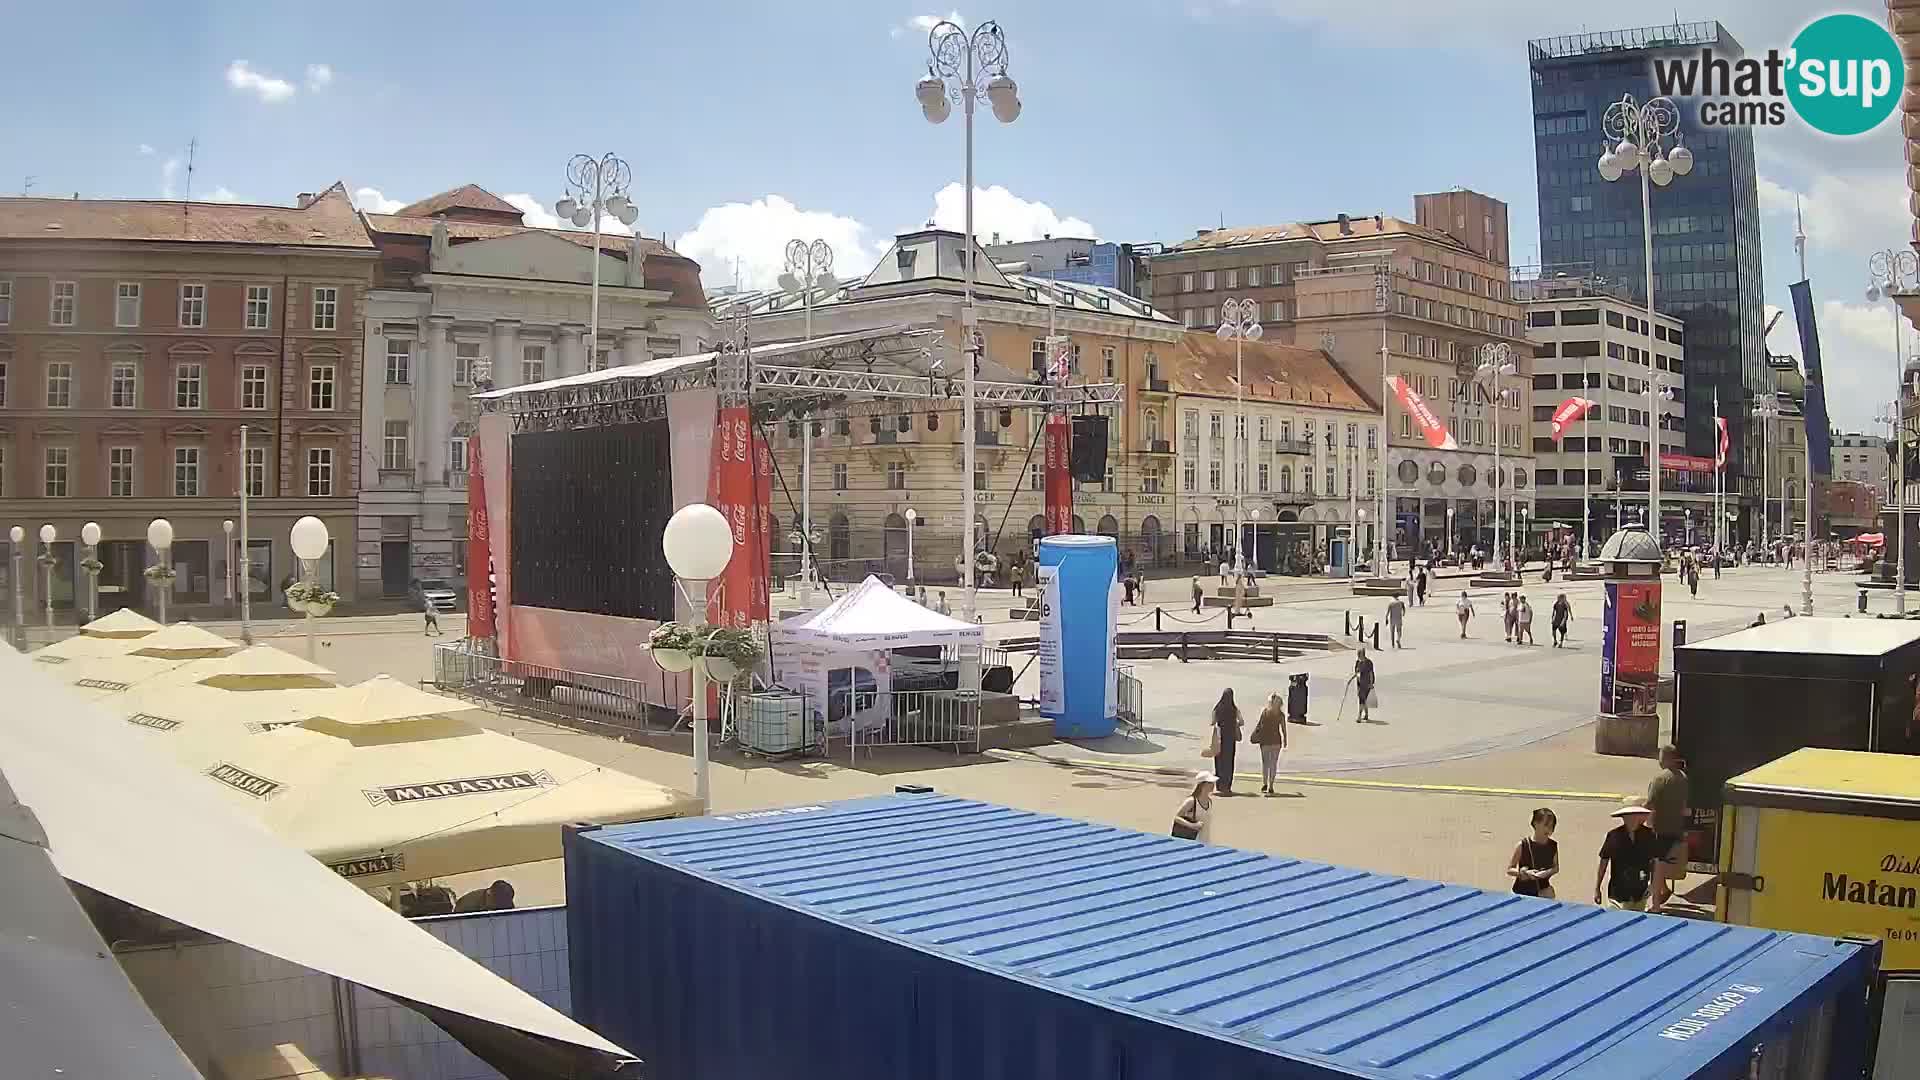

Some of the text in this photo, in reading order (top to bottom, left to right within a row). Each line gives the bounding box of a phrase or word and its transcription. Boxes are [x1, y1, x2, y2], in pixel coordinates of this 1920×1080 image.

[394, 775, 532, 801] MARASKA
[333, 857, 389, 877] RASKA
[1822, 871, 1917, 909] Matan
